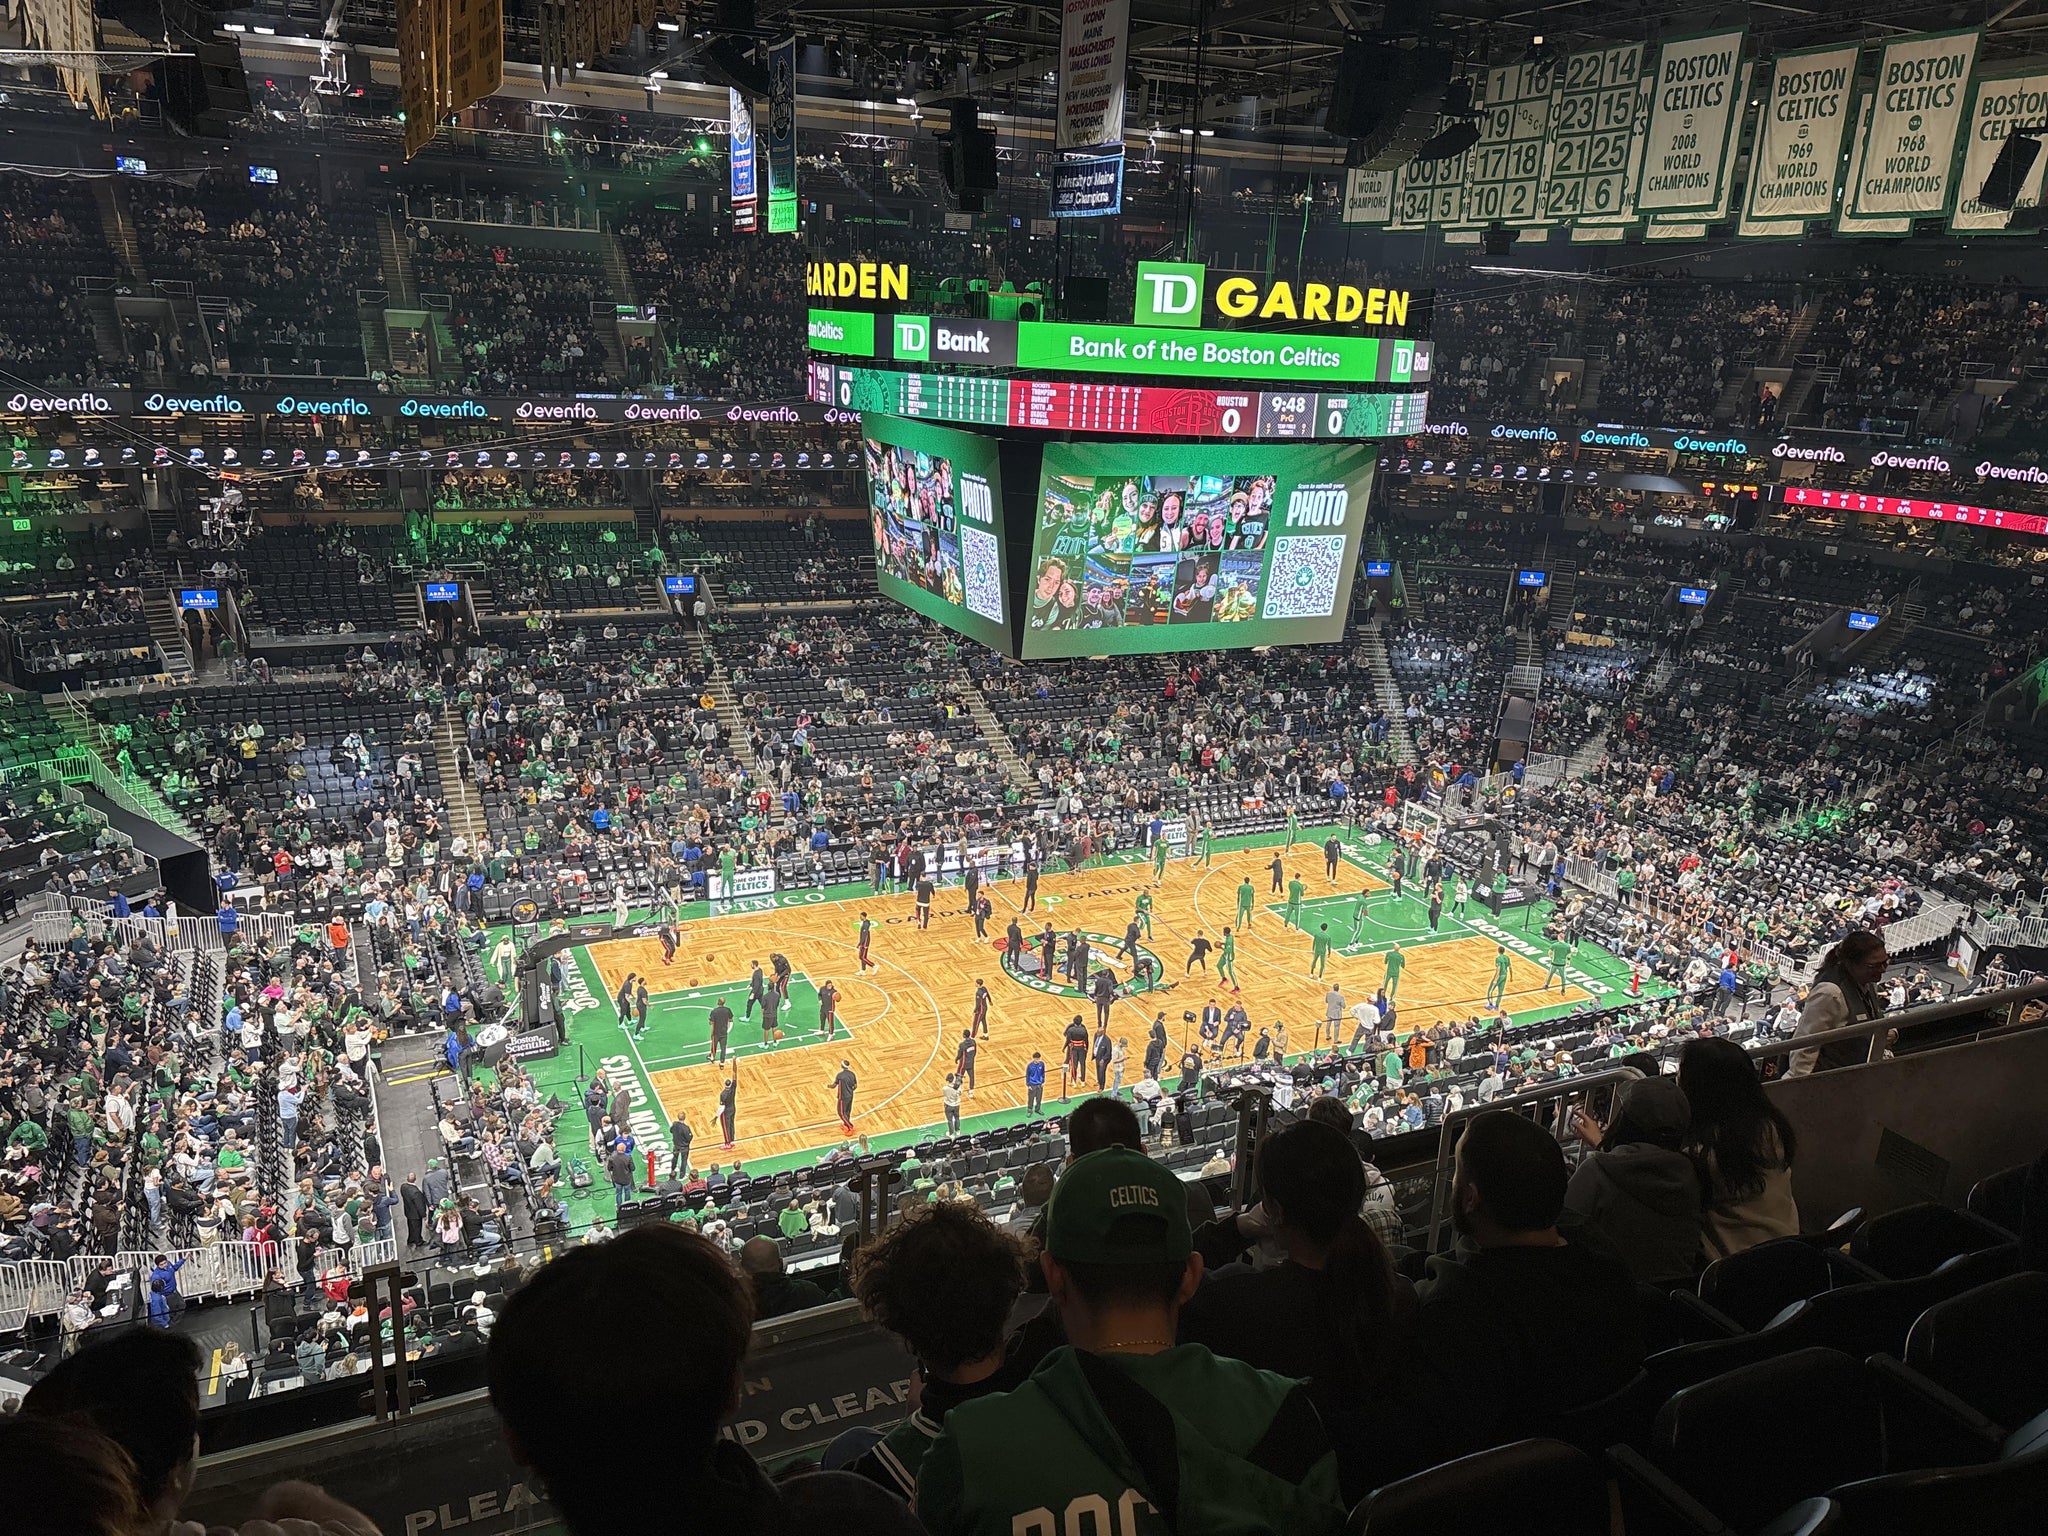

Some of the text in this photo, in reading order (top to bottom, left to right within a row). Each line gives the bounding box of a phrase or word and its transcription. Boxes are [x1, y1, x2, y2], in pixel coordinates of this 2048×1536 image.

[1069, 37, 1115, 58] MASSACHUSETTS
[1566, 54, 1599, 90] 22
[1609, 50, 1637, 84] 14
[1664, 51, 1732, 83] BOSTON
[1887, 53, 1966, 86] BOSTON
[1079, 83, 1112, 99] HAMPSHIRE
[1496, 72, 1506, 98] 1
[1778, 67, 1847, 97] BOSTON
[1663, 81, 1724, 111] CELTICS
[1886, 83, 1956, 112] CELTICS
[1560, 96, 1594, 130] 23
[1605, 91, 1631, 126] 15
[1777, 94, 1839, 123] CELTICS
[1487, 108, 1509, 138] 19
[1591, 135, 1625, 167] 25
[1671, 133, 1697, 150] 2008
[1787, 142, 1814, 160] 1969
[1897, 134, 1926, 152] 1968
[1480, 149, 1504, 178] 17
[1512, 147, 1538, 176] 18
[1557, 139, 1590, 172] 21
[1663, 153, 1701, 170] WORLD
[1885, 154, 1931, 173] WORLD
[1777, 161, 1818, 179] WORLD
[1056, 172, 1086, 189] University
[1358, 179, 1382, 194] WORLD
[1649, 172, 1710, 191] CHAMPIONS
[1759, 180, 1828, 199] CHAMPIONS
[1866, 174, 1941, 195] CHAMPIONS
[1075, 190, 1109, 206] Champions
[1349, 196, 1387, 209] CHAMPIONS
[1475, 186, 1499, 216] 10
[1512, 185, 1526, 213] 2
[1548, 181, 1580, 212] 24
[1595, 178, 1611, 210] 6
[1405, 192, 1429, 219] 34
[1441, 191, 1451, 218] 5
[1944, 259, 1964, 267] 307
[807, 262, 909, 300] GARDEN
[1143, 273, 1410, 326] TD GARDEN
[817, 321, 843, 341] Celtics
[897, 323, 990, 353] TD Bank
[1070, 336, 1341, 368] Bank of the Boston Celtics
[1396, 348, 1412, 374] TD
[166, 395, 245, 413] evenflo.
[297, 399, 371, 416] evenflo.
[419, 401, 488, 417] evenflo.
[534, 402, 599, 419] evenflo.
[640, 404, 702, 420] evenflo.
[1217, 396, 1249, 408] HOUSTON
[1272, 397, 1306, 413] 9:48
[742, 406, 801, 422] evenflo.
[1222, 409, 1241, 434] 0
[1280, 414, 1294, 422] PrG
[1328, 411, 1343, 434] 0
[1424, 421, 1469, 436] venflo.
[1505, 427, 1558, 441] evenflo.
[1595, 432, 1650, 447] evenflo.
[1689, 437, 1748, 454] evenflo.
[1786, 446, 1846, 462] evenflo.
[1887, 455, 1951, 472] evenflo.
[960, 478, 993, 525] PHOTO
[1286, 490, 1349, 527] PHOTO
[15, 519, 28, 530] 20
[528, 512, 545, 520] 109
[1897, 506, 1911, 514] 0/0
[1956, 512, 1967, 520] 0.0
[1979, 515, 1984, 523] 7
[1167, 832, 1187, 840] ELTIC
[1068, 883, 1161, 900] GARDEN
[716, 892, 826, 915] PIMCO
[1466, 918, 1543, 955] BOSTON
[505, 1037, 550, 1054] Scientific
[510, 1035, 539, 1046] Boston
[1110, 1185, 1158, 1208] CELTICS
[404, 1482, 541, 1536] PLEA
